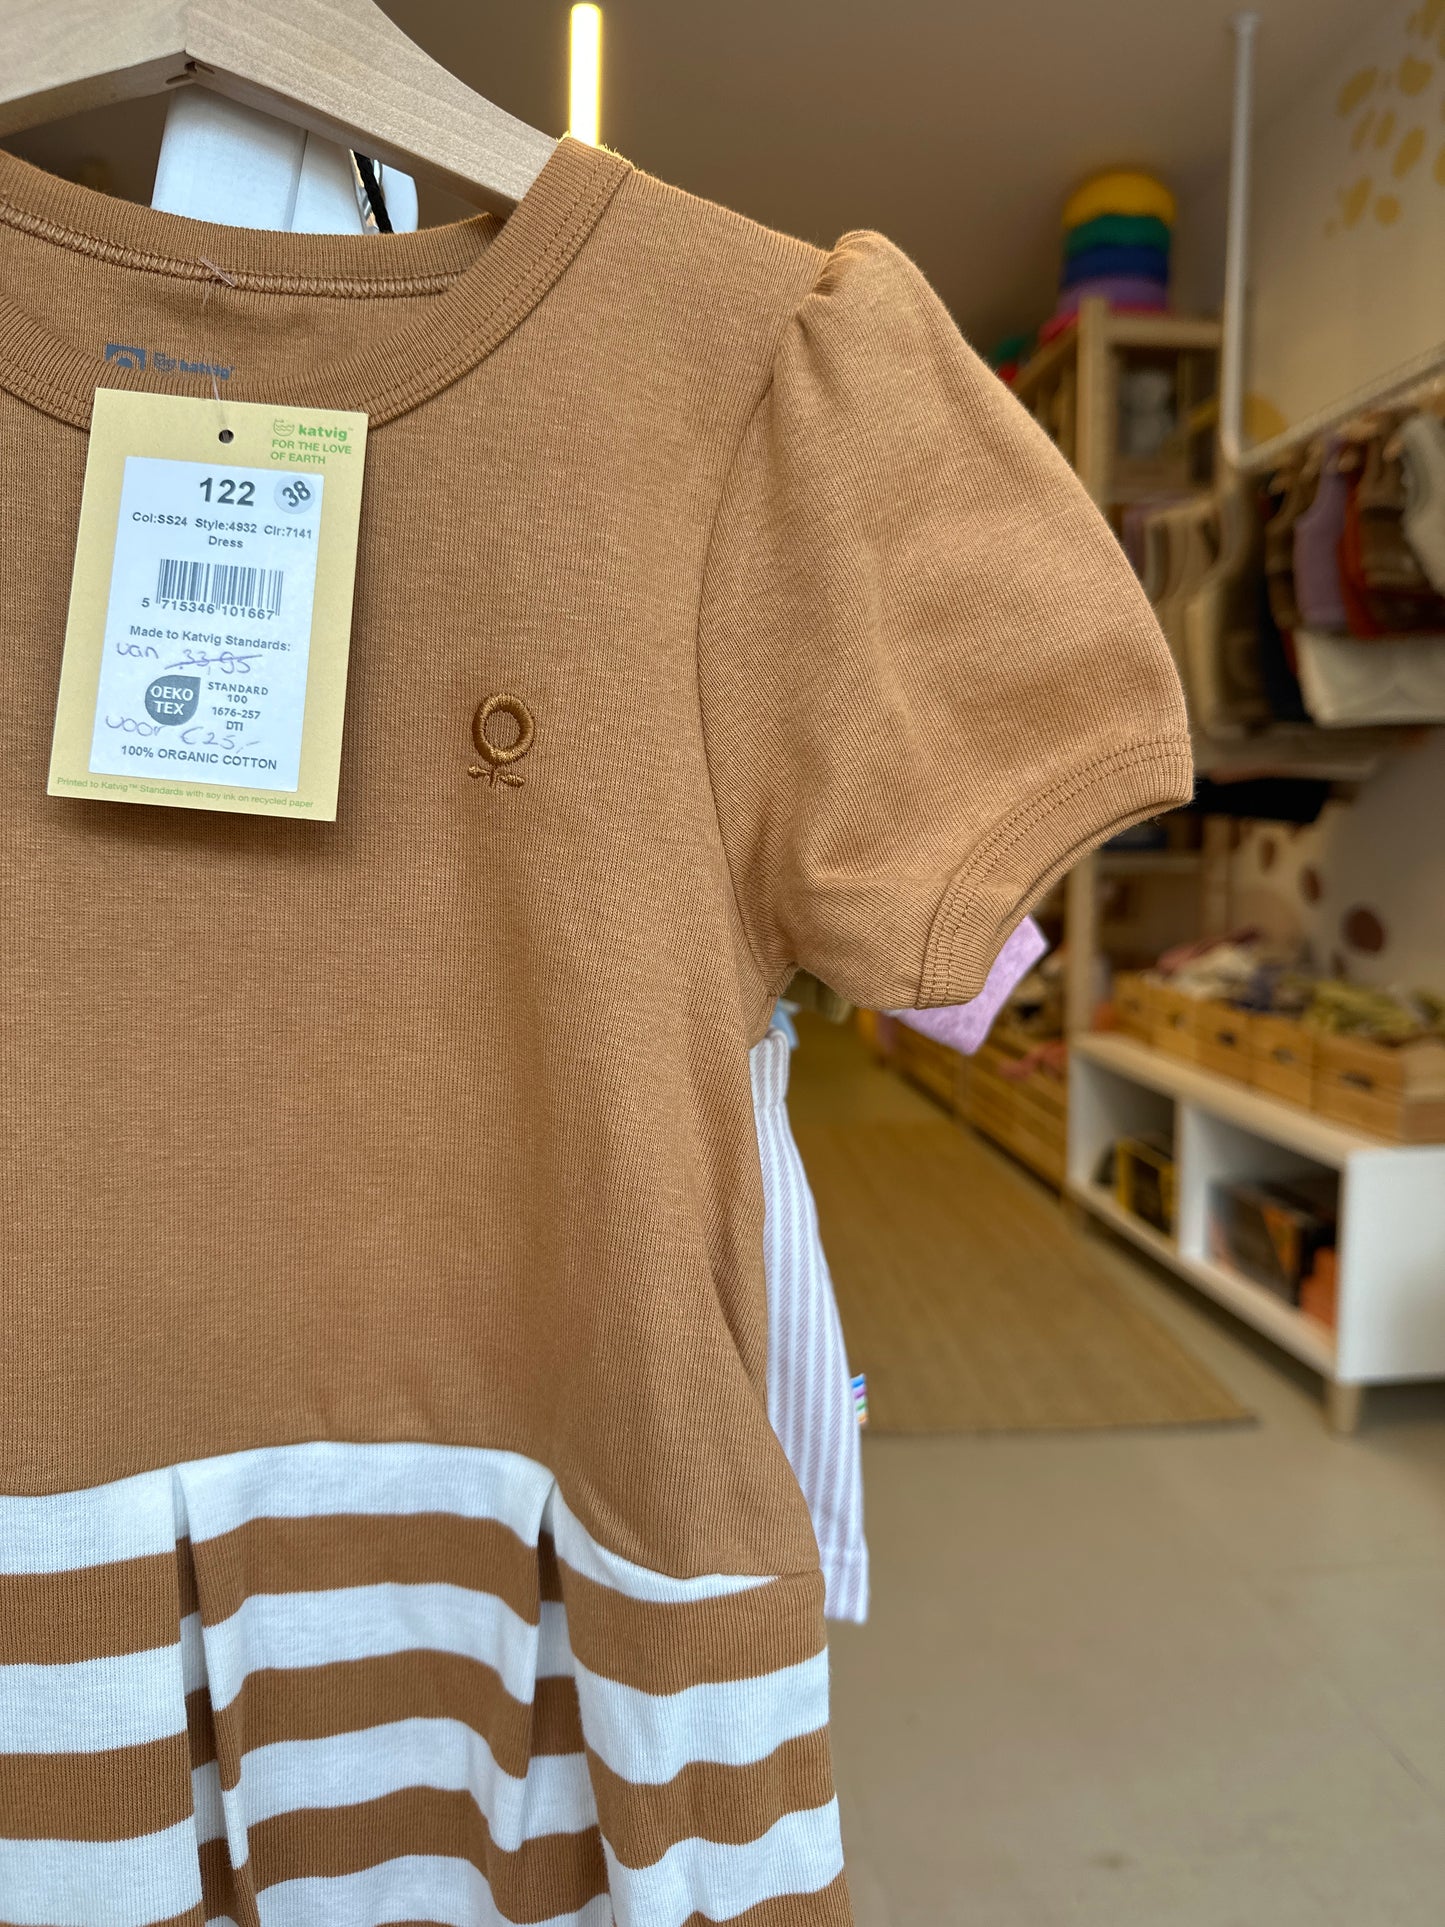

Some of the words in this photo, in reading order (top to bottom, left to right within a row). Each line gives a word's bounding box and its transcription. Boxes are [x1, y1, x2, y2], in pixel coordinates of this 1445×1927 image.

[298, 424, 348, 442] katvig
[271, 439, 295, 449] FOR
[298, 441, 320, 452] THE
[323, 443, 352, 454] LOVE
[270, 451, 286, 460] OF
[288, 452, 326, 465] EARTH
[199, 477, 256, 507] 122
[282, 480, 311, 508] 38
[132, 512, 188, 527] Col:SS24
[195, 518, 257, 534] Style:4932
[264, 525, 312, 539] Clr:7141
[208, 535, 244, 549] Dress
[141, 597, 151, 608] 5
[161, 600, 215, 615] 715346
[222, 606, 275, 621] 101667
[129, 625, 163, 639] Made
[166, 629, 179, 640] to
[182, 631, 222, 647] Katvig
[225, 635, 291, 652] Standards:
[150, 685, 194, 701] OEKO
[208, 681, 269, 696] STANDARD
[227, 694, 248, 704] 100
[154, 701, 185, 716] TEX
[212, 706, 261, 720] 1676-257
[226, 720, 244, 732] DTI
[121, 745, 154, 759] 100%
[158, 748, 219, 764] ORGANIC
[222, 755, 277, 770] COTTON
[57, 777, 88, 787] Printed
[90, 780, 99, 788] to
[140, 784, 184, 795] Standards
[186, 790, 204, 798] with
[206, 792, 221, 800] soy
[223, 793, 237, 801] ink
[251, 796, 287, 806] recycled
[289, 799, 314, 808] paper
